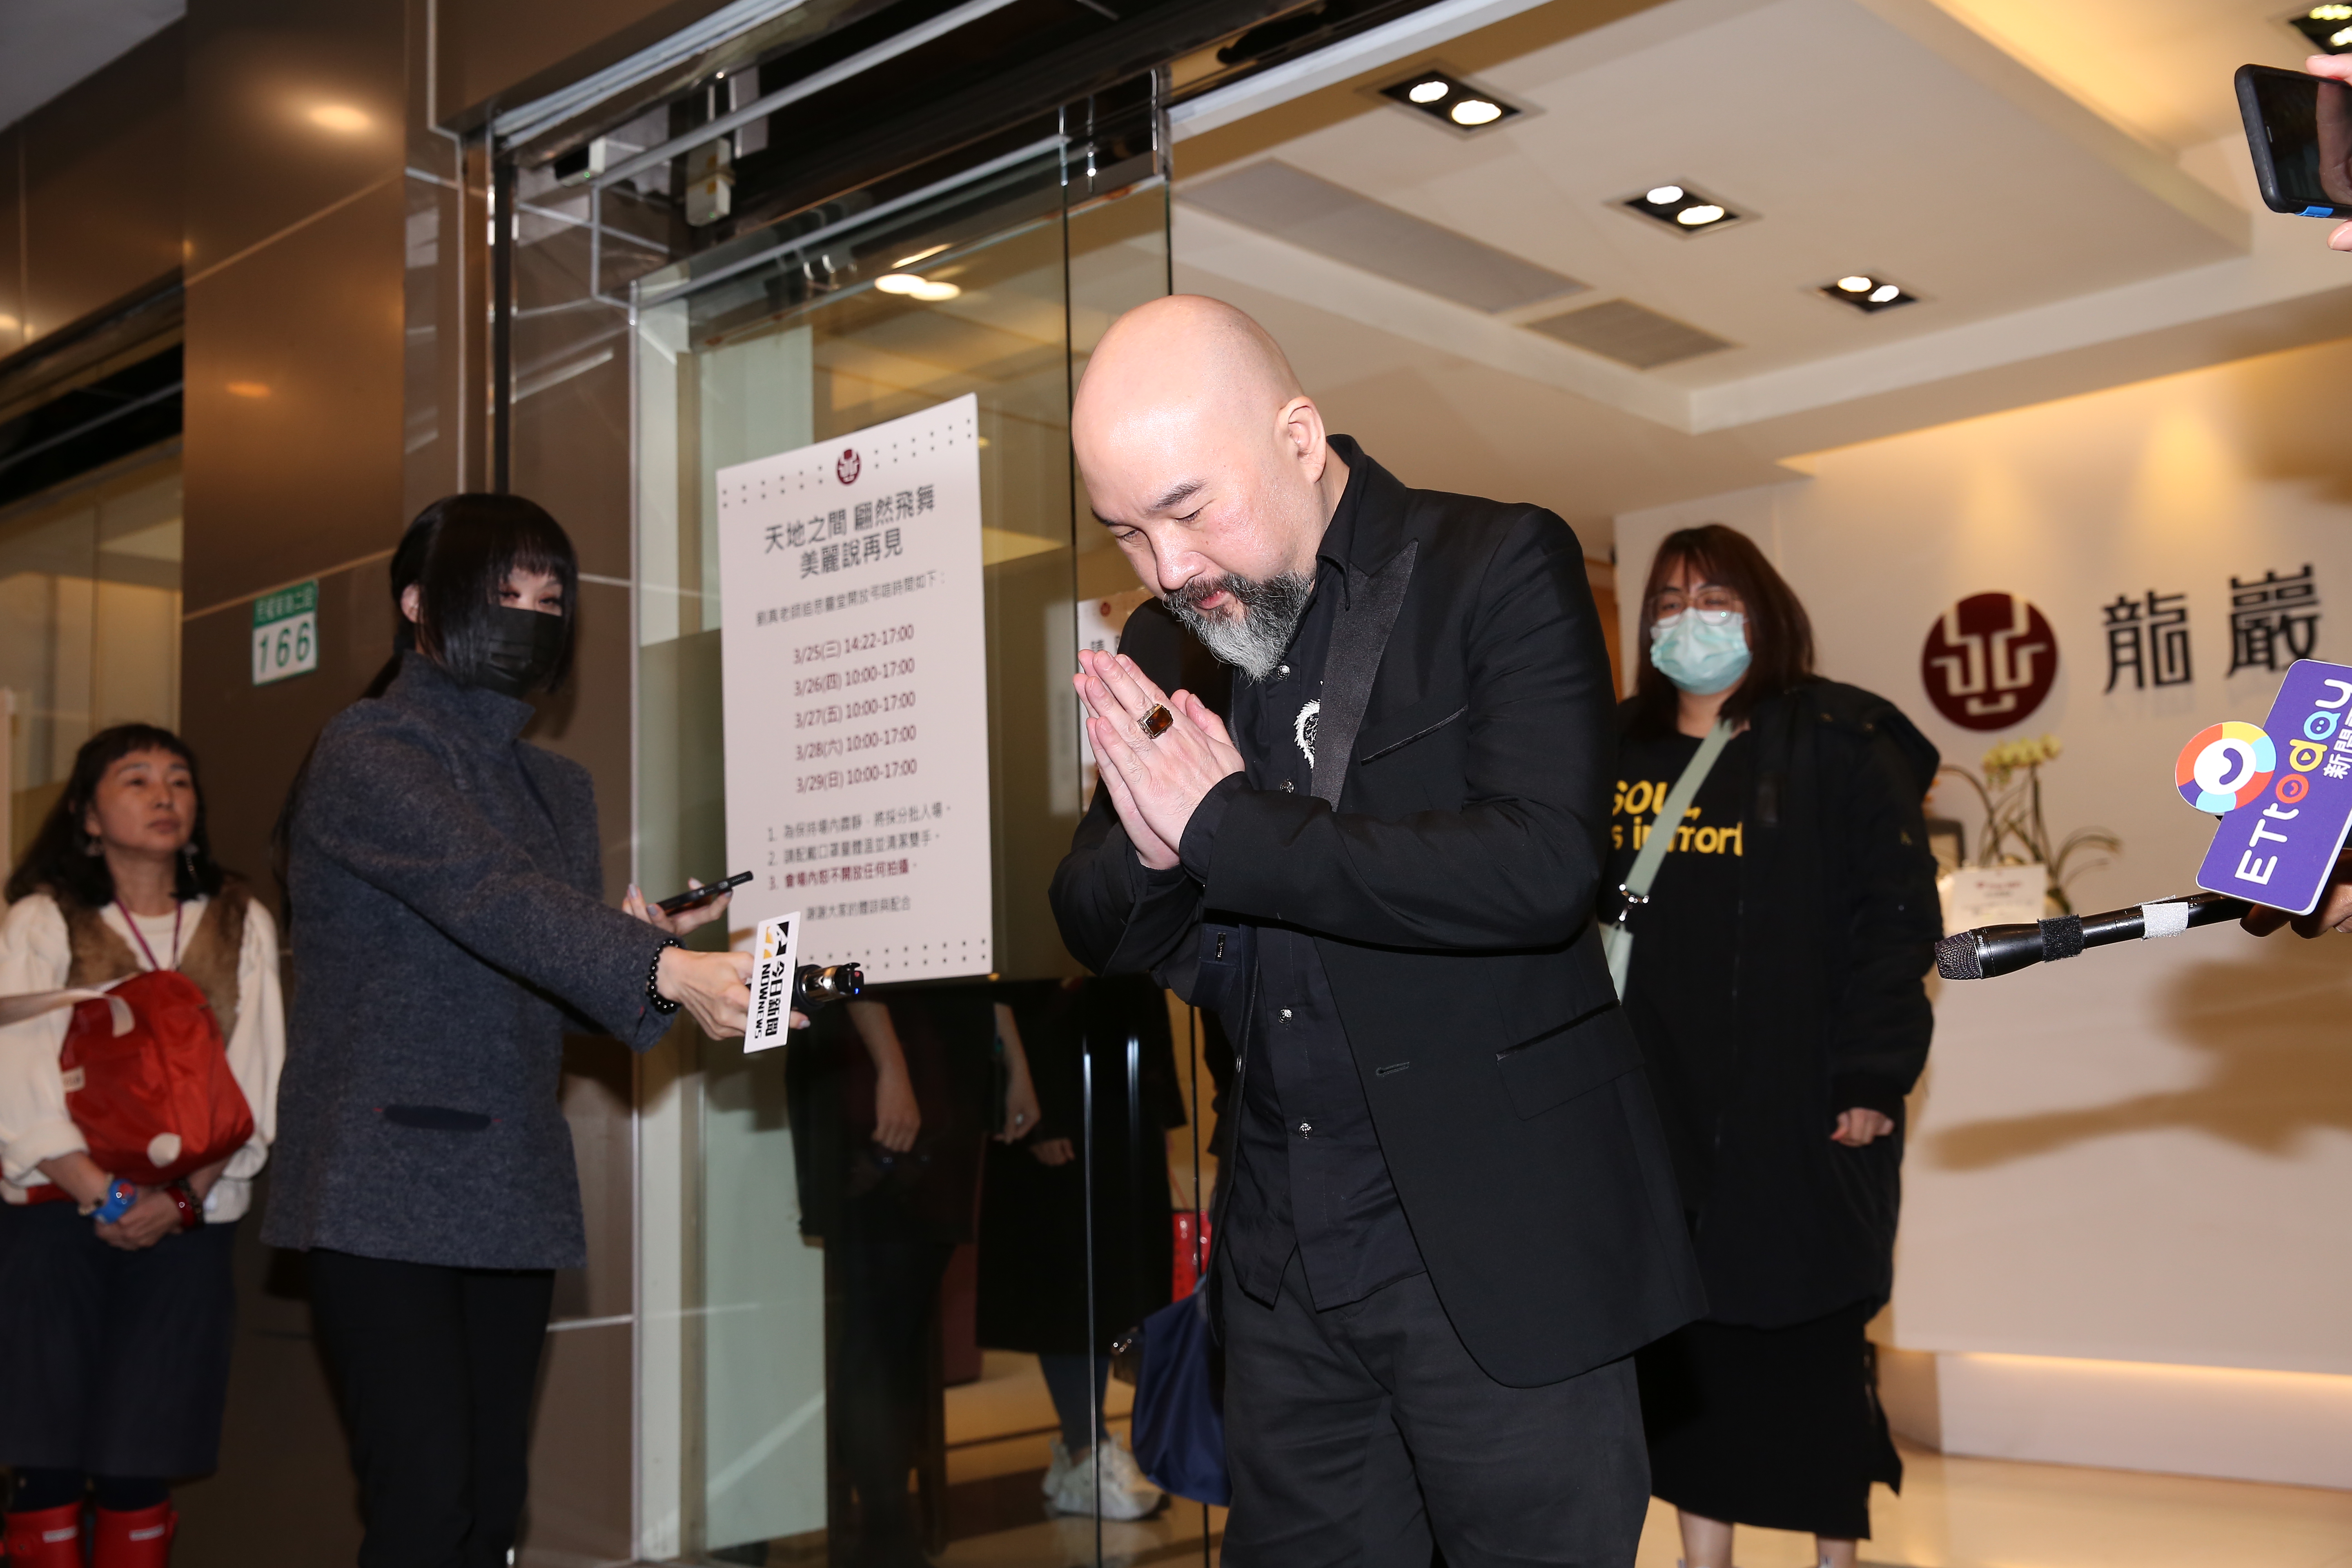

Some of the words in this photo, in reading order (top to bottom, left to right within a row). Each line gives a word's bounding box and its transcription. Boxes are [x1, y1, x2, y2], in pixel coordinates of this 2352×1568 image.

[764, 509, 847, 554] 天地之間
[854, 484, 935, 531] 翩然飛舞
[800, 528, 904, 579] 美麗說再見
[259, 621, 311, 673] 166
[793, 639, 842, 665] 3/25(三)
[844, 624, 915, 654] 14:22-17:00
[2102, 564, 2328, 694] 龍巖
[794, 673, 842, 697] 3/26(四)
[845, 657, 915, 687] 10:00-17:00
[795, 704, 843, 729] 3/27(五)
[846, 690, 916, 719] 10:00-17:00
[796, 737, 844, 762] 3/28(六)
[847, 724, 917, 752] 10:00-17:00
[2323, 706, 2352, 780] 新聞
[796, 770, 844, 794] 3/29(日)
[847, 757, 918, 785] 10:00-17:00
[2234, 678, 2352, 886] ETtoday
[765, 960, 785, 1036] 今日新聞
